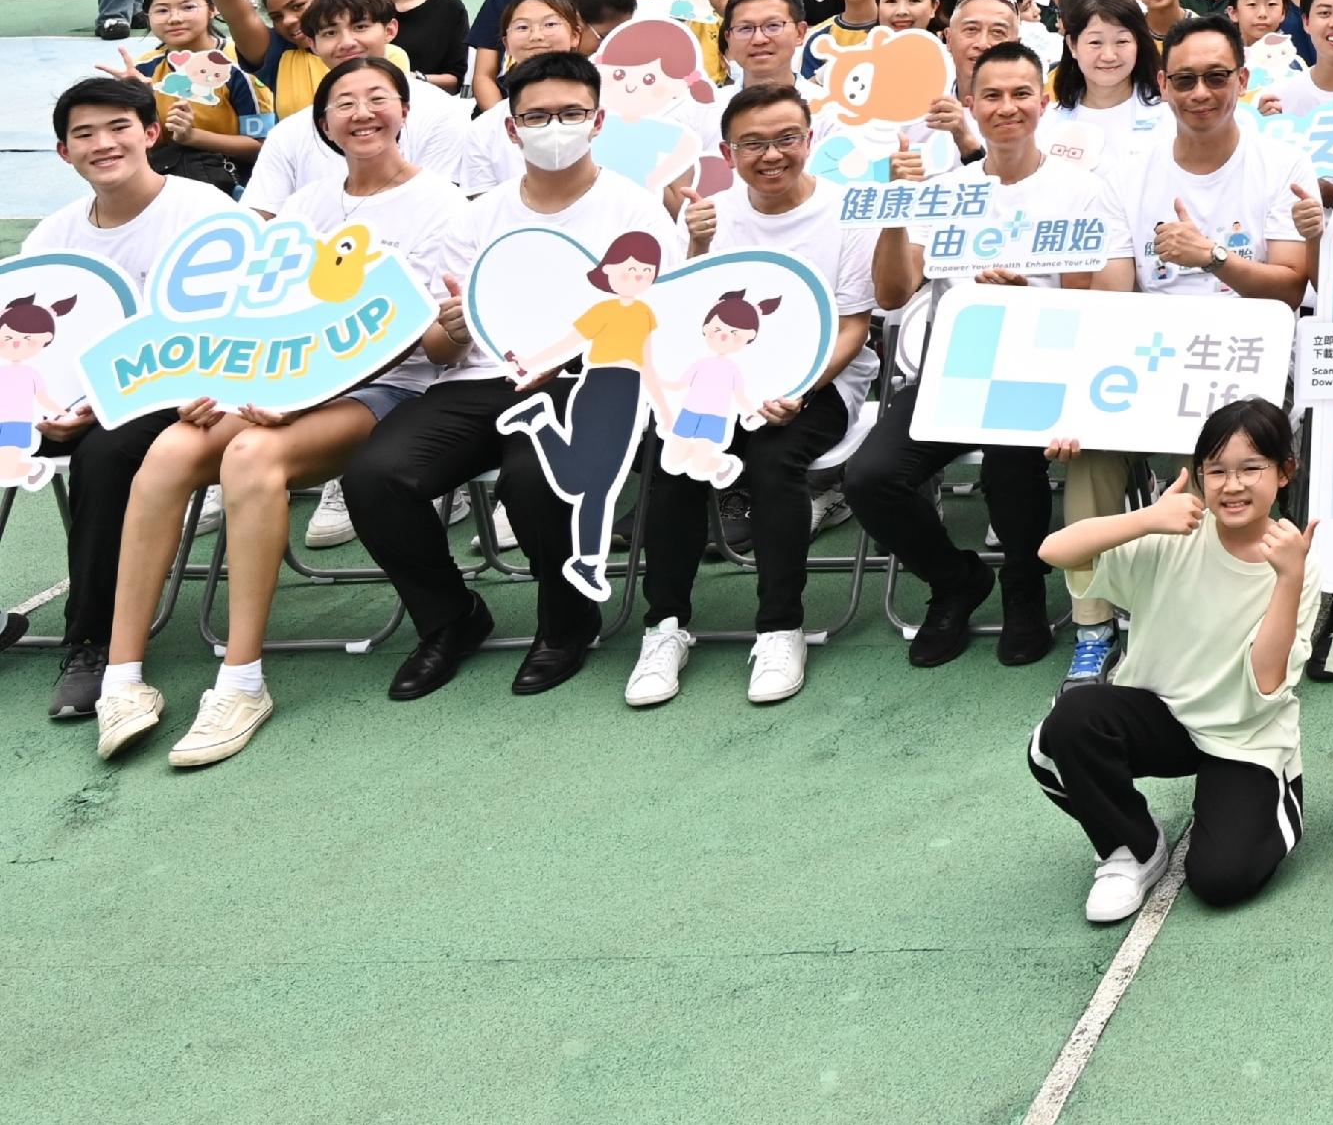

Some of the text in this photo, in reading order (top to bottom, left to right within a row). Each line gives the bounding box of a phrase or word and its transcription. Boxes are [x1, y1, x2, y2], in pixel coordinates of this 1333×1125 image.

[246, 117, 263, 135] D
[840, 182, 992, 221] 健康生活
[929, 264, 969, 273] Empower
[1025, 260, 1062, 268] Enhance
[1085, 258, 1101, 266] Life
[114, 297, 391, 392] MOVE IT UP
[1184, 334, 1265, 374] 生活
[1177, 381, 1262, 418] Lif
